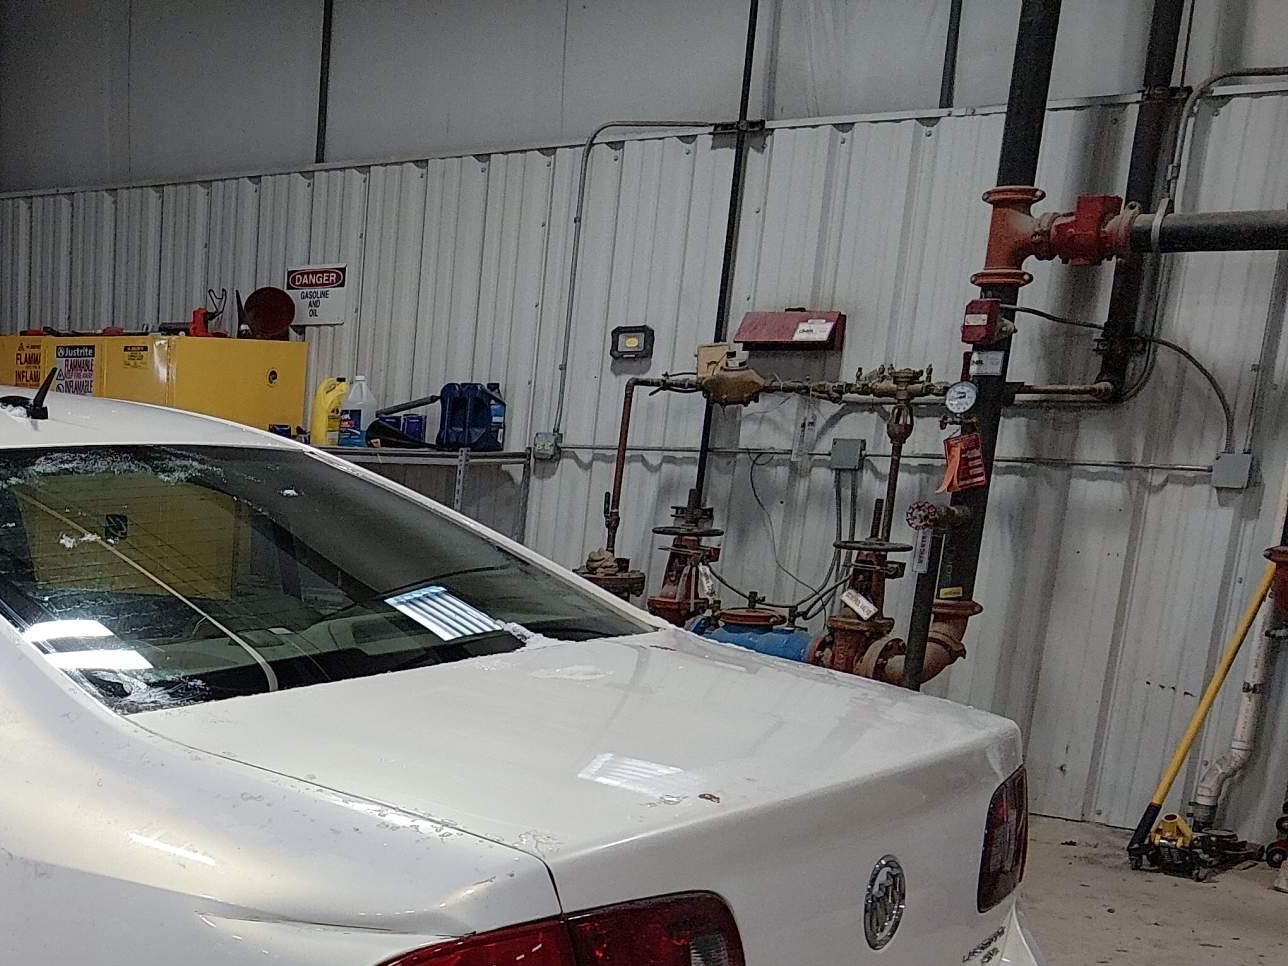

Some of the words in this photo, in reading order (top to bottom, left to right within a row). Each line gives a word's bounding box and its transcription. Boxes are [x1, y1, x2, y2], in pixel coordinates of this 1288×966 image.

[295, 273, 337, 285] DANGER
[300, 290, 329, 300] GASOLINE
[307, 300, 321, 309] AND
[308, 309, 318, 317] OIL
[64, 346, 93, 357] Justrite
[64, 359, 93, 372] FLAMMABLE
